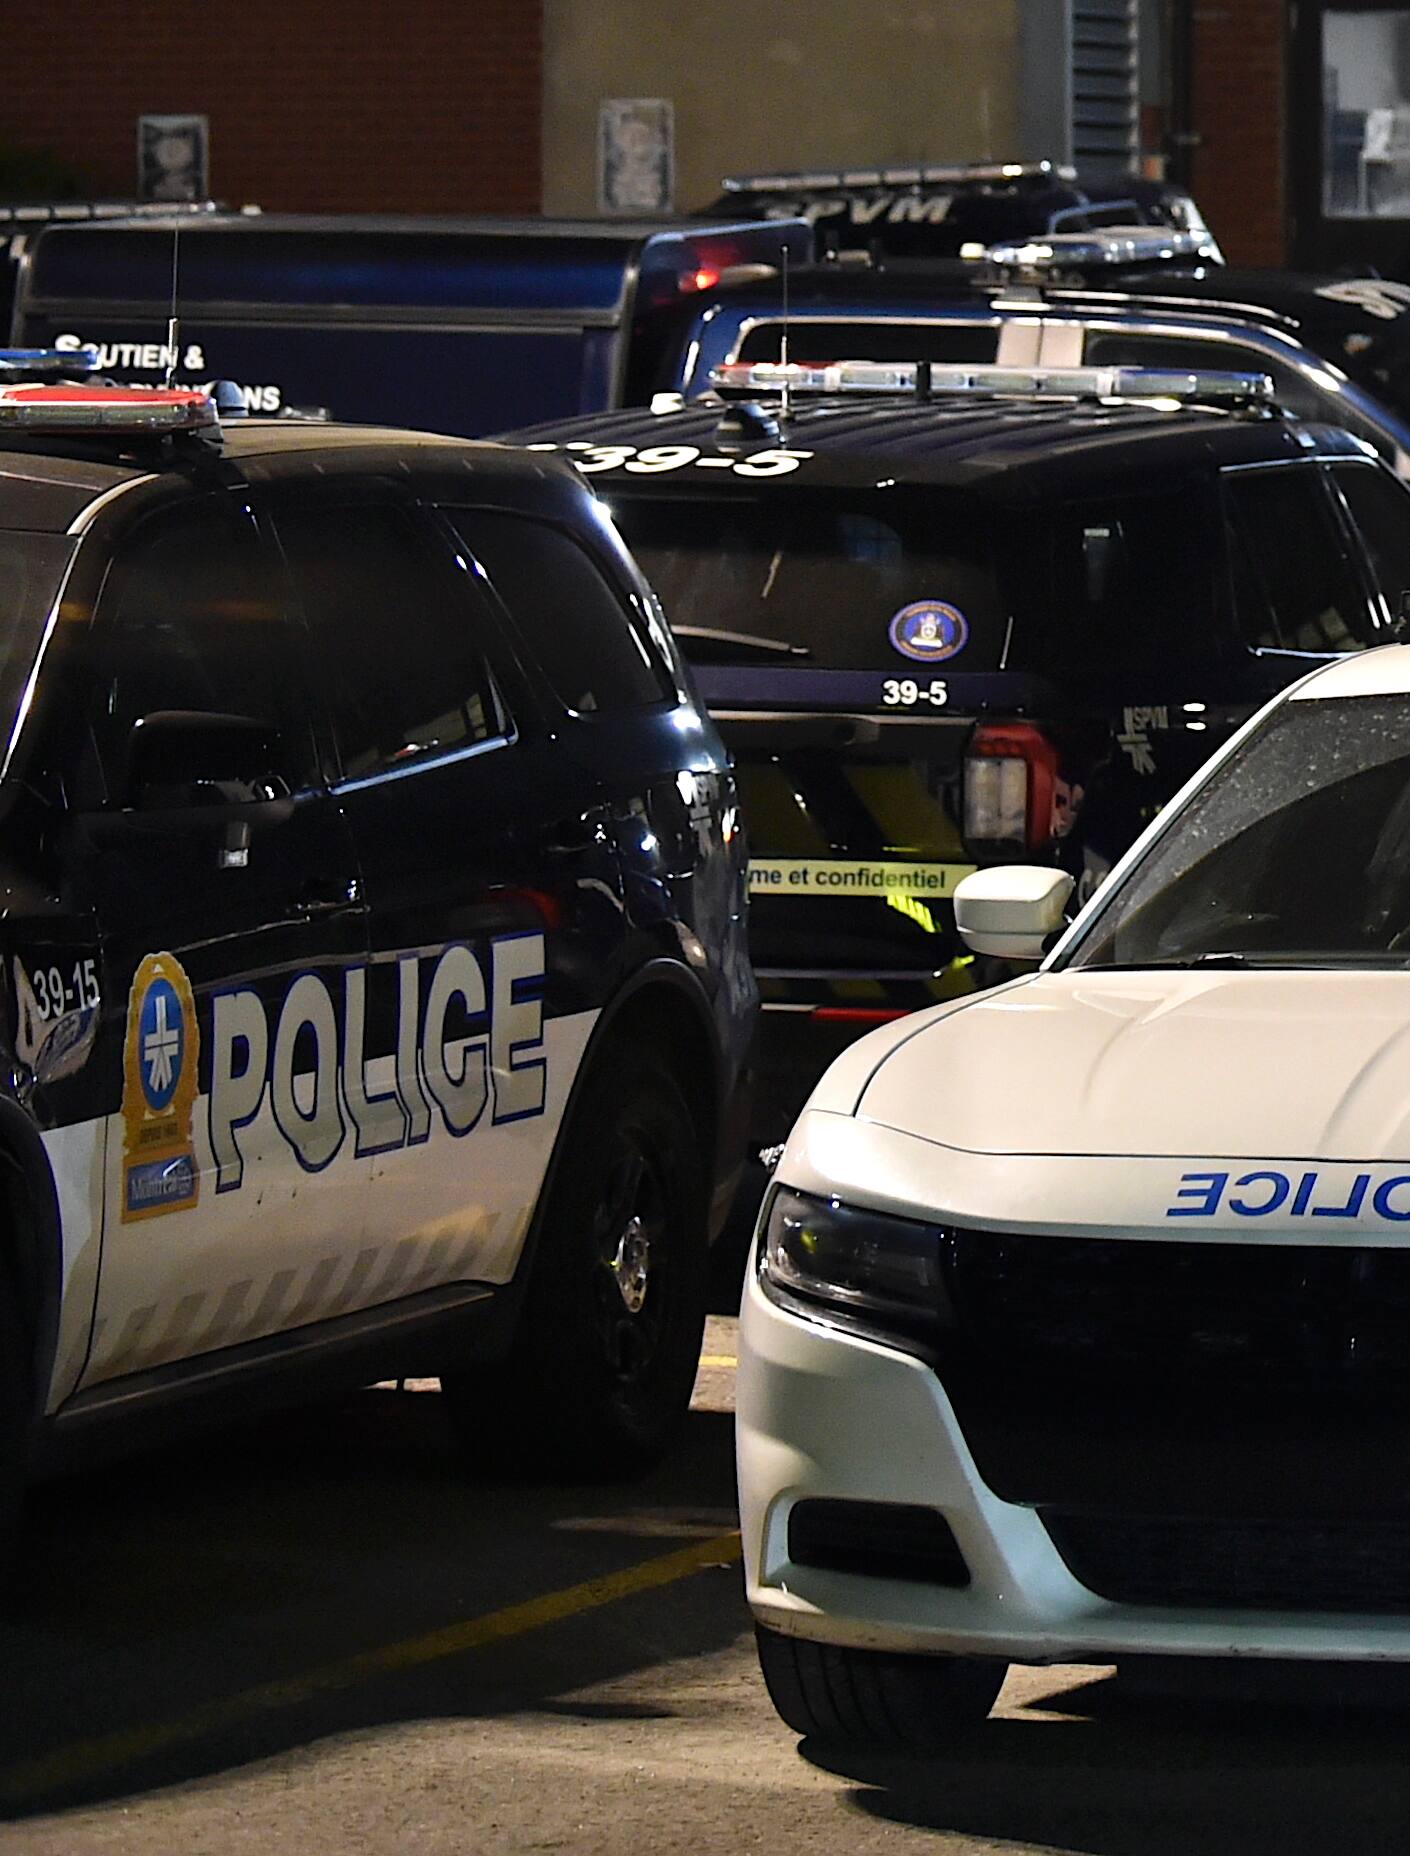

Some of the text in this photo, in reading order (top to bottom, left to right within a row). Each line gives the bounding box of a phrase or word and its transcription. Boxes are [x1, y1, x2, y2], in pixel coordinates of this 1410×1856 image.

[183, 345, 205, 370] &
[574, 446, 814, 477] 39-5
[883, 680, 947, 705] 39-5
[789, 869, 808, 885] et
[815, 868, 946, 888] confidentiel
[33, 959, 101, 1020] 39-15
[209, 929, 547, 1195] POLICE
